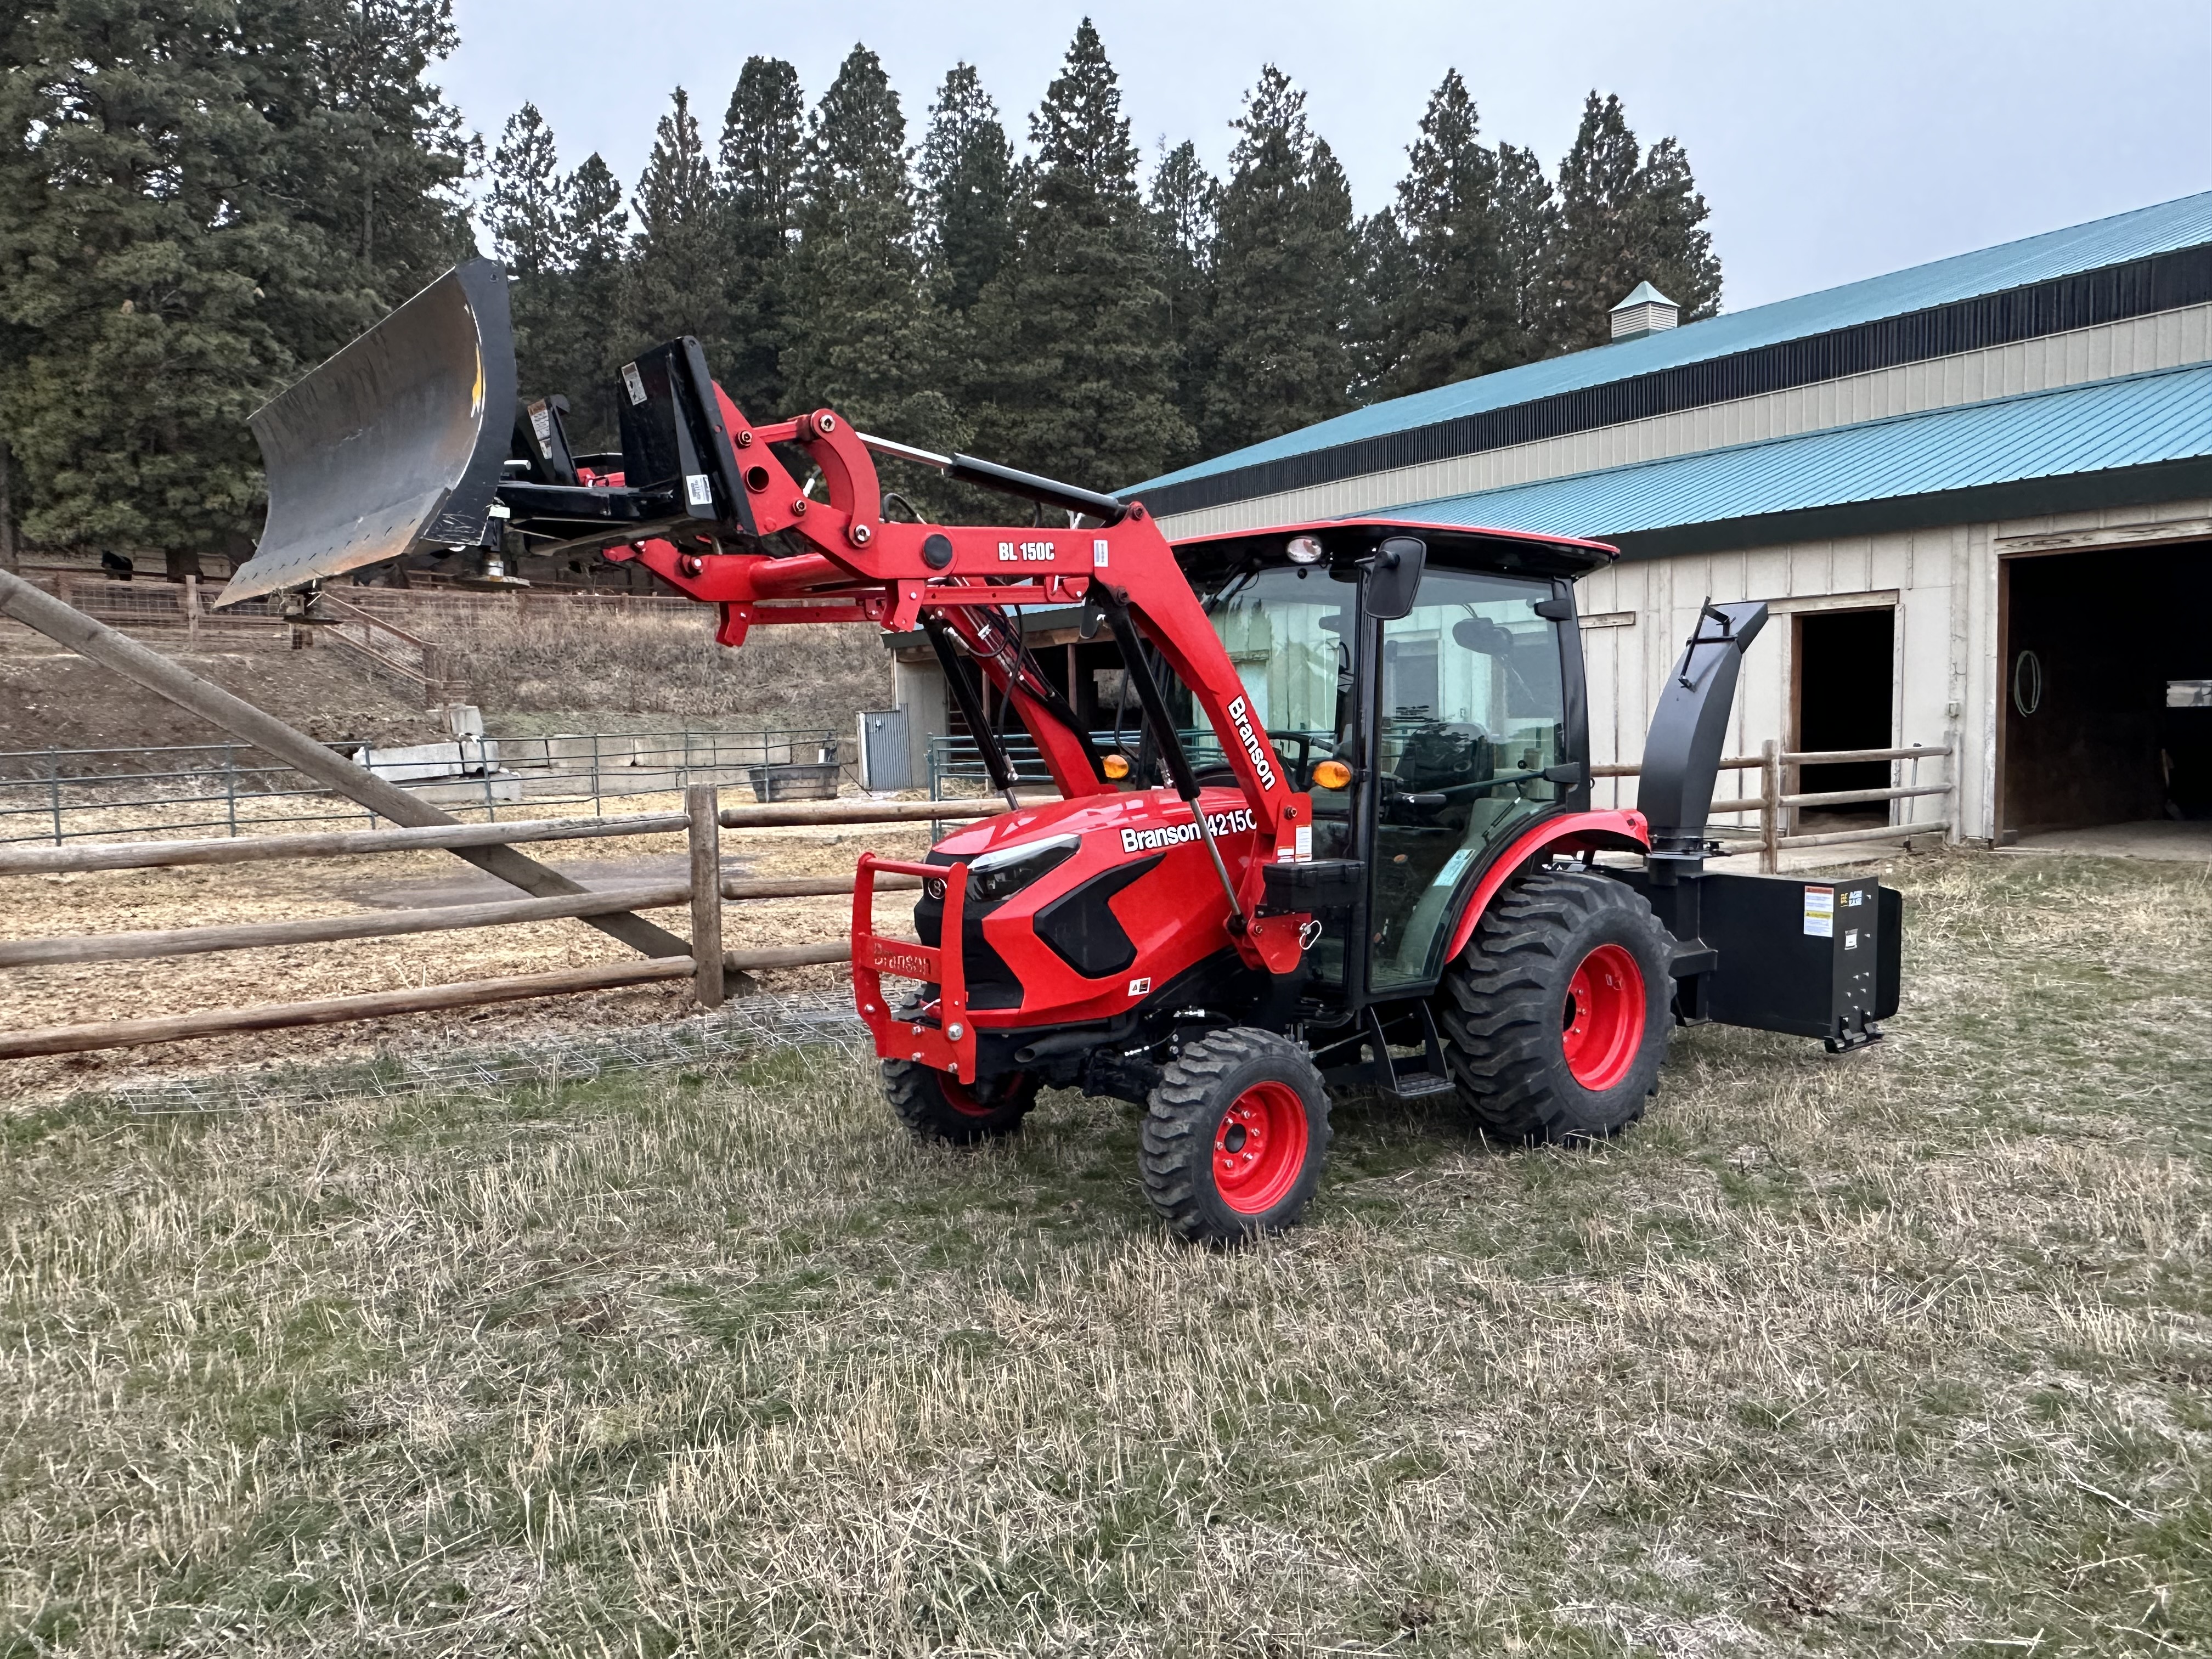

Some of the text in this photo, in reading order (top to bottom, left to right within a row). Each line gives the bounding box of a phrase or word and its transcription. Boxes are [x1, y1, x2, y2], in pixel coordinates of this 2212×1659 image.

[998, 542, 1055, 561] BL 150C
[1227, 695, 1276, 791] Branson
[1120, 808, 1257, 853] Branson 4215C
